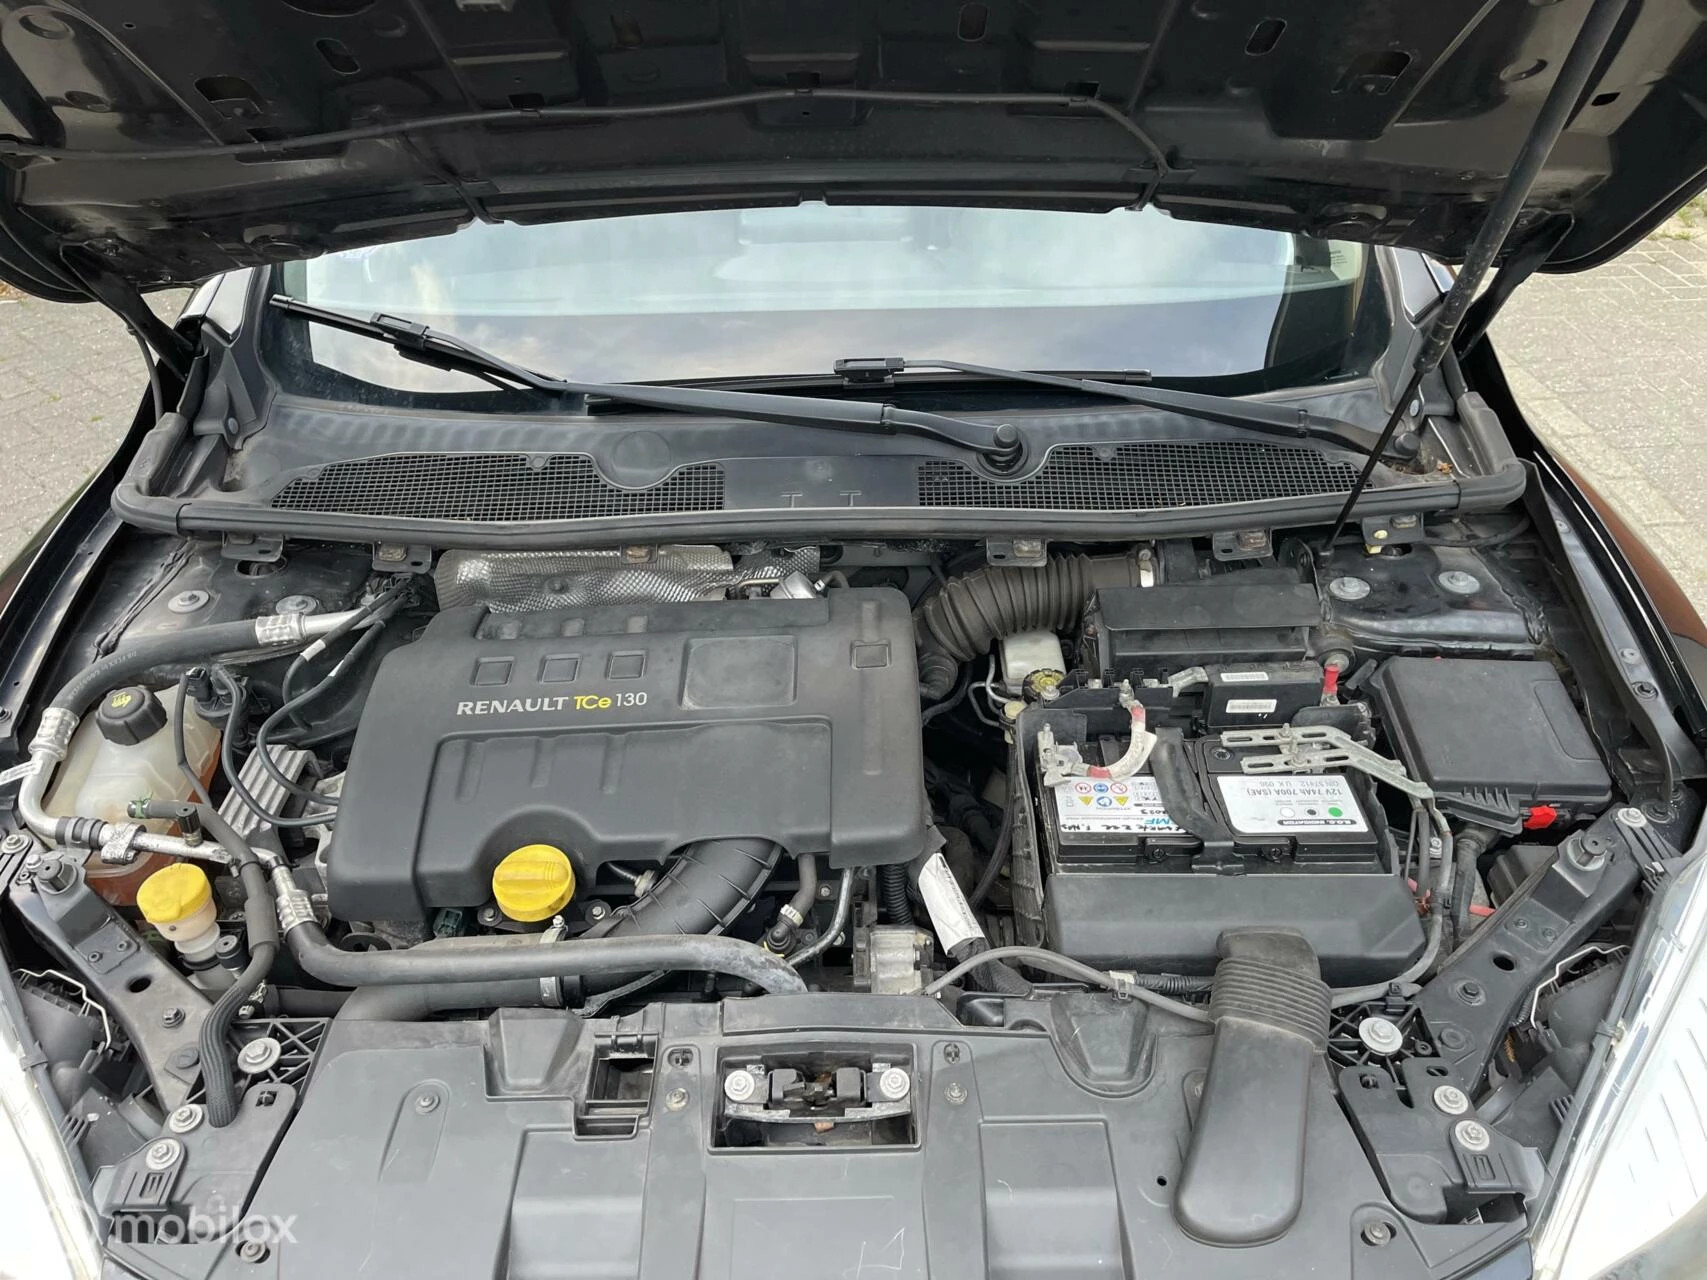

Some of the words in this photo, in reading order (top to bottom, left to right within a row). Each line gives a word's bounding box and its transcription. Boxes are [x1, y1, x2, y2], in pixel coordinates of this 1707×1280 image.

[457, 697, 568, 715] RENAULT
[573, 695, 611, 711] TCe
[615, 692, 647, 707] 130
[1273, 788, 1298, 796] 700A
[1299, 788, 1324, 796] 74Ah
[1326, 788, 1343, 796] 12V
